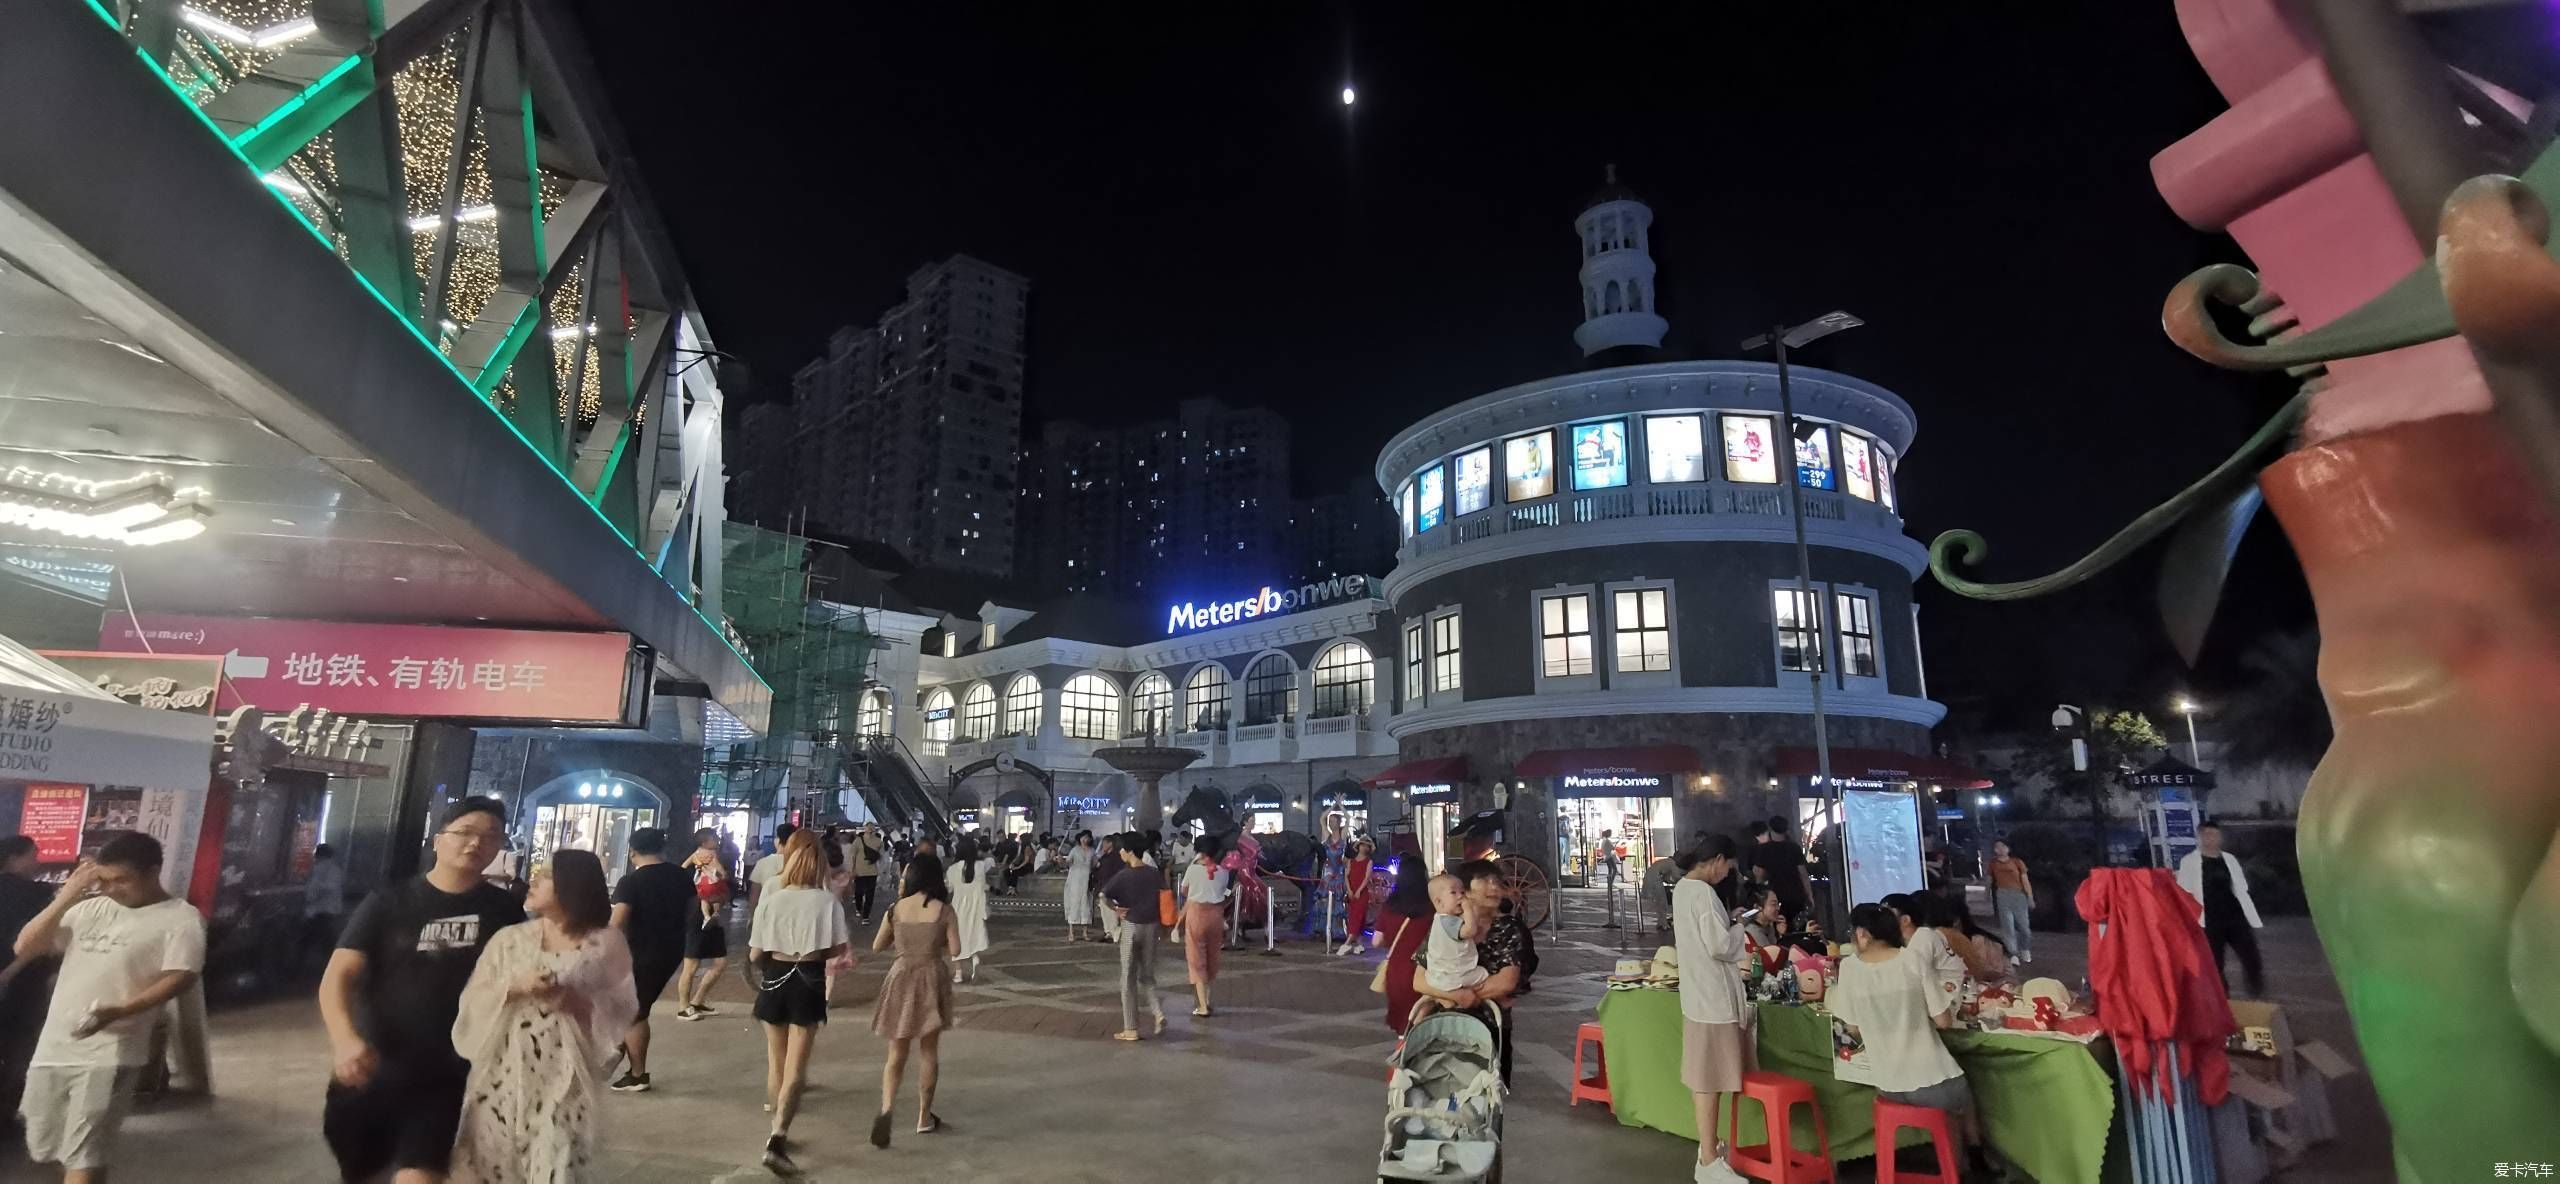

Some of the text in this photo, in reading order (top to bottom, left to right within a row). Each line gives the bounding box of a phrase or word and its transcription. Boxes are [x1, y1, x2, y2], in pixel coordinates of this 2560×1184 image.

[1810, 469, 1826, 480] 299
[1811, 479, 1822, 488] 50
[282, 652, 547, 692] 地铁、有轨电车
[2134, 774, 2195, 785] STREET
